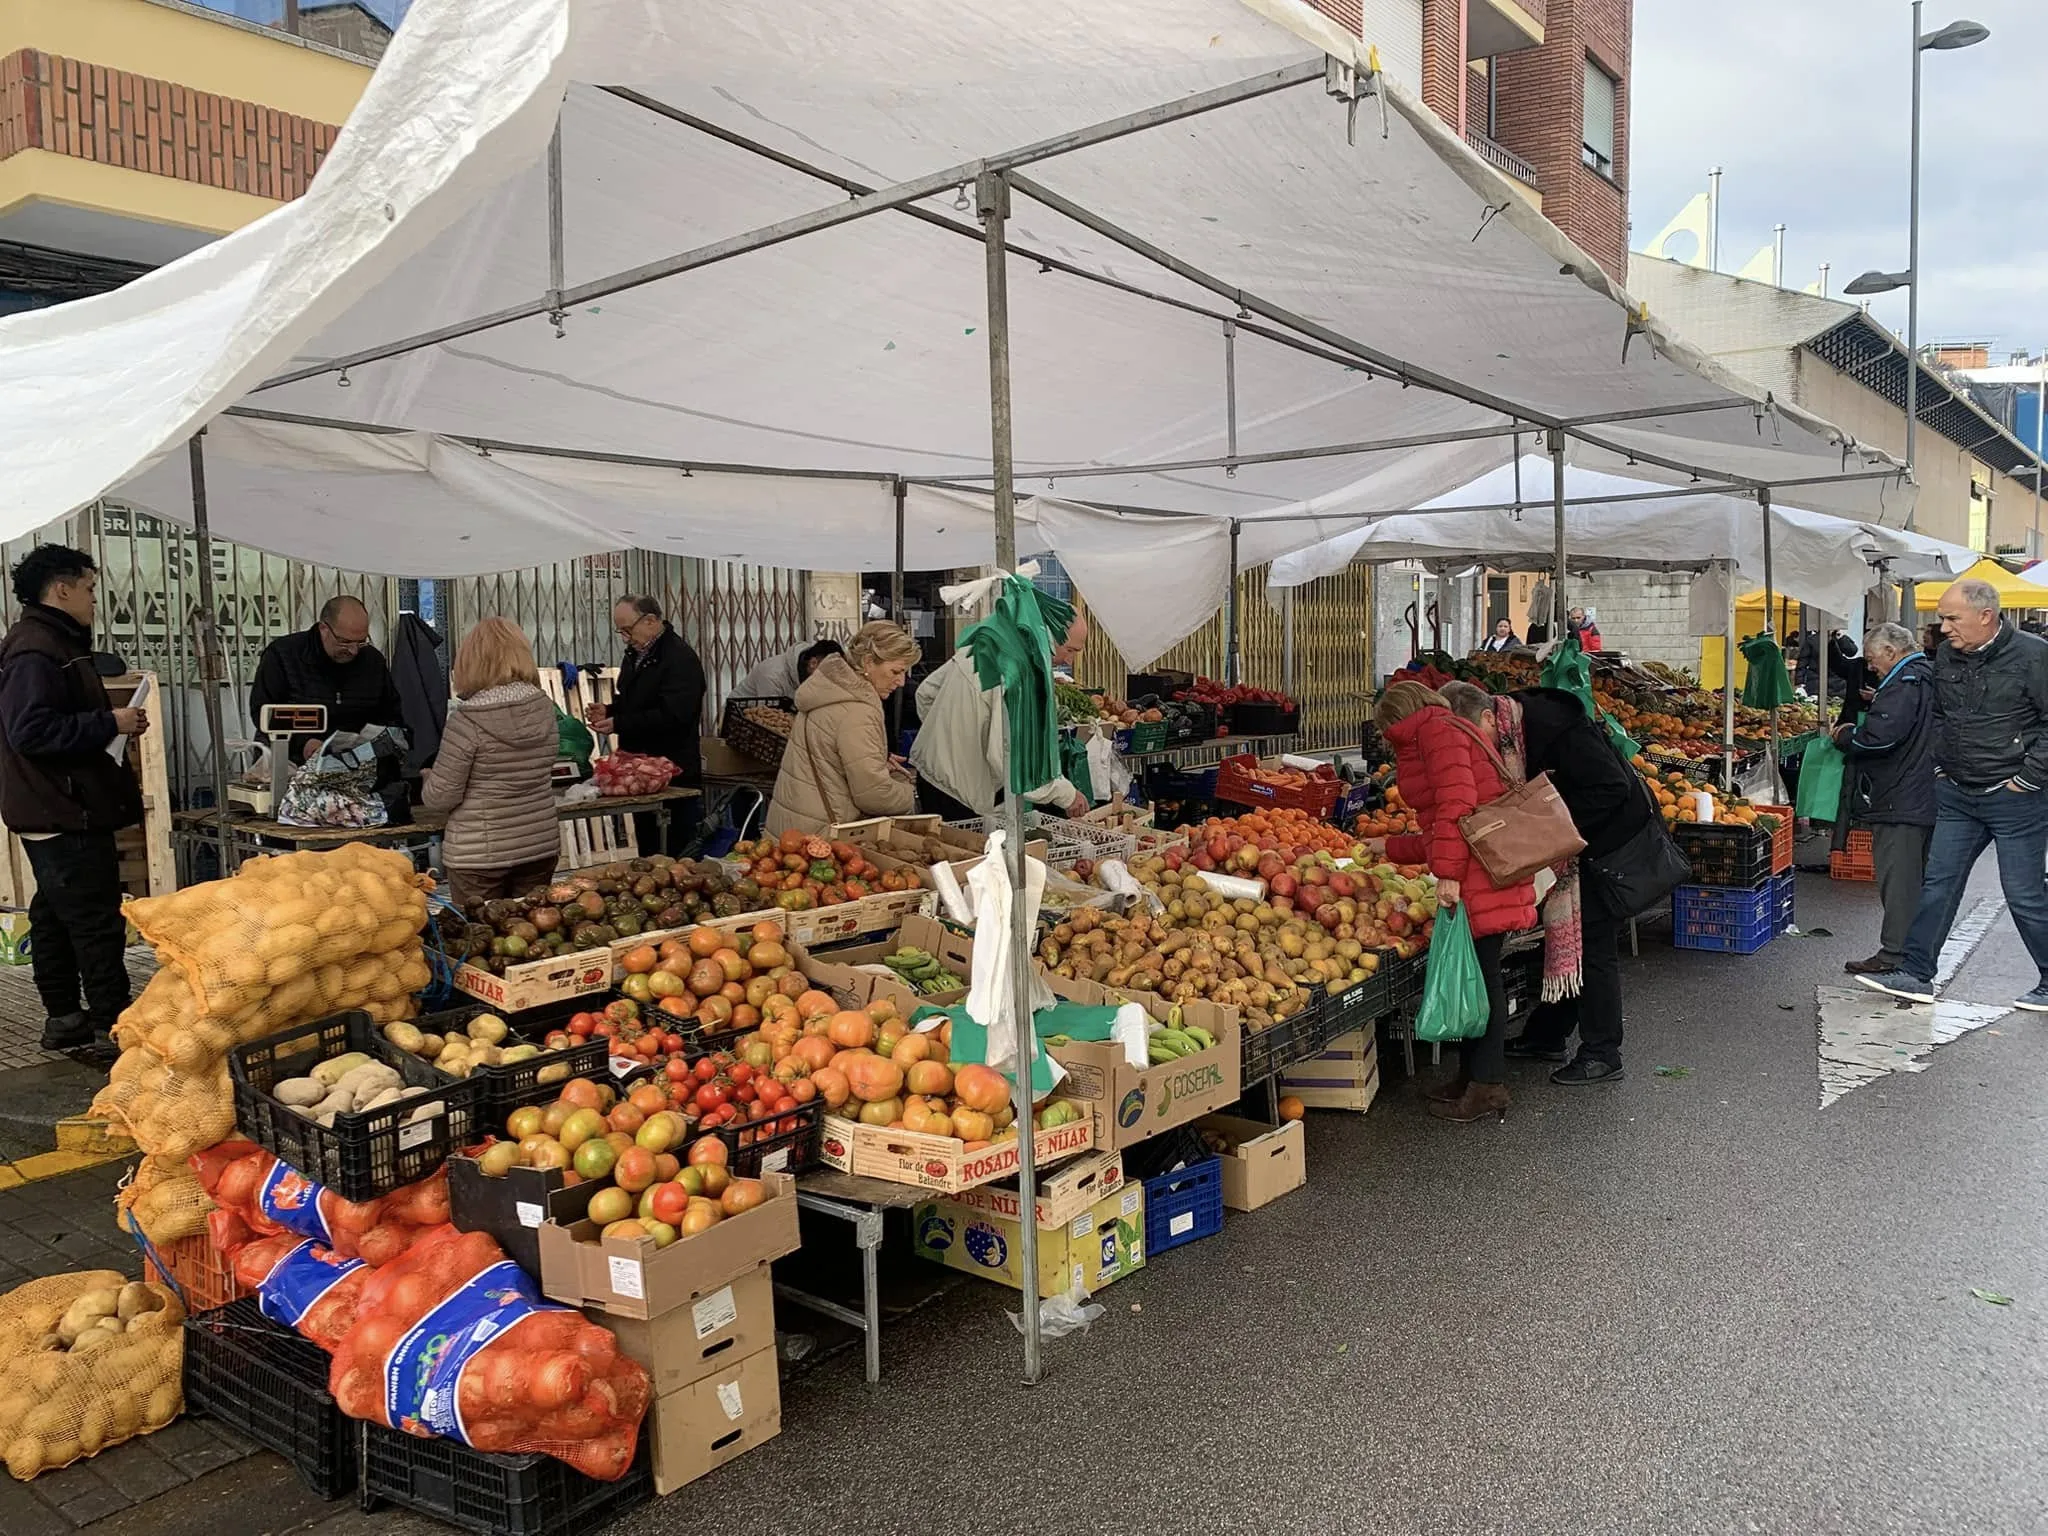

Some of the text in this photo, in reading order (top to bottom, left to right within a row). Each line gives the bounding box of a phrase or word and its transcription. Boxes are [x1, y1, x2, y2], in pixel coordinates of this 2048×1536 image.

[465, 972, 504, 1003] NÍJAR
[1048, 1127, 1088, 1156] NÍJAR
[898, 1158, 924, 1173] Flor de
[918, 1173, 952, 1190] Balandre
[967, 1192, 985, 1208] DE
[990, 1194, 1045, 1222] NÍJR
[391, 1328, 426, 1412] SPANISH ONIONS
